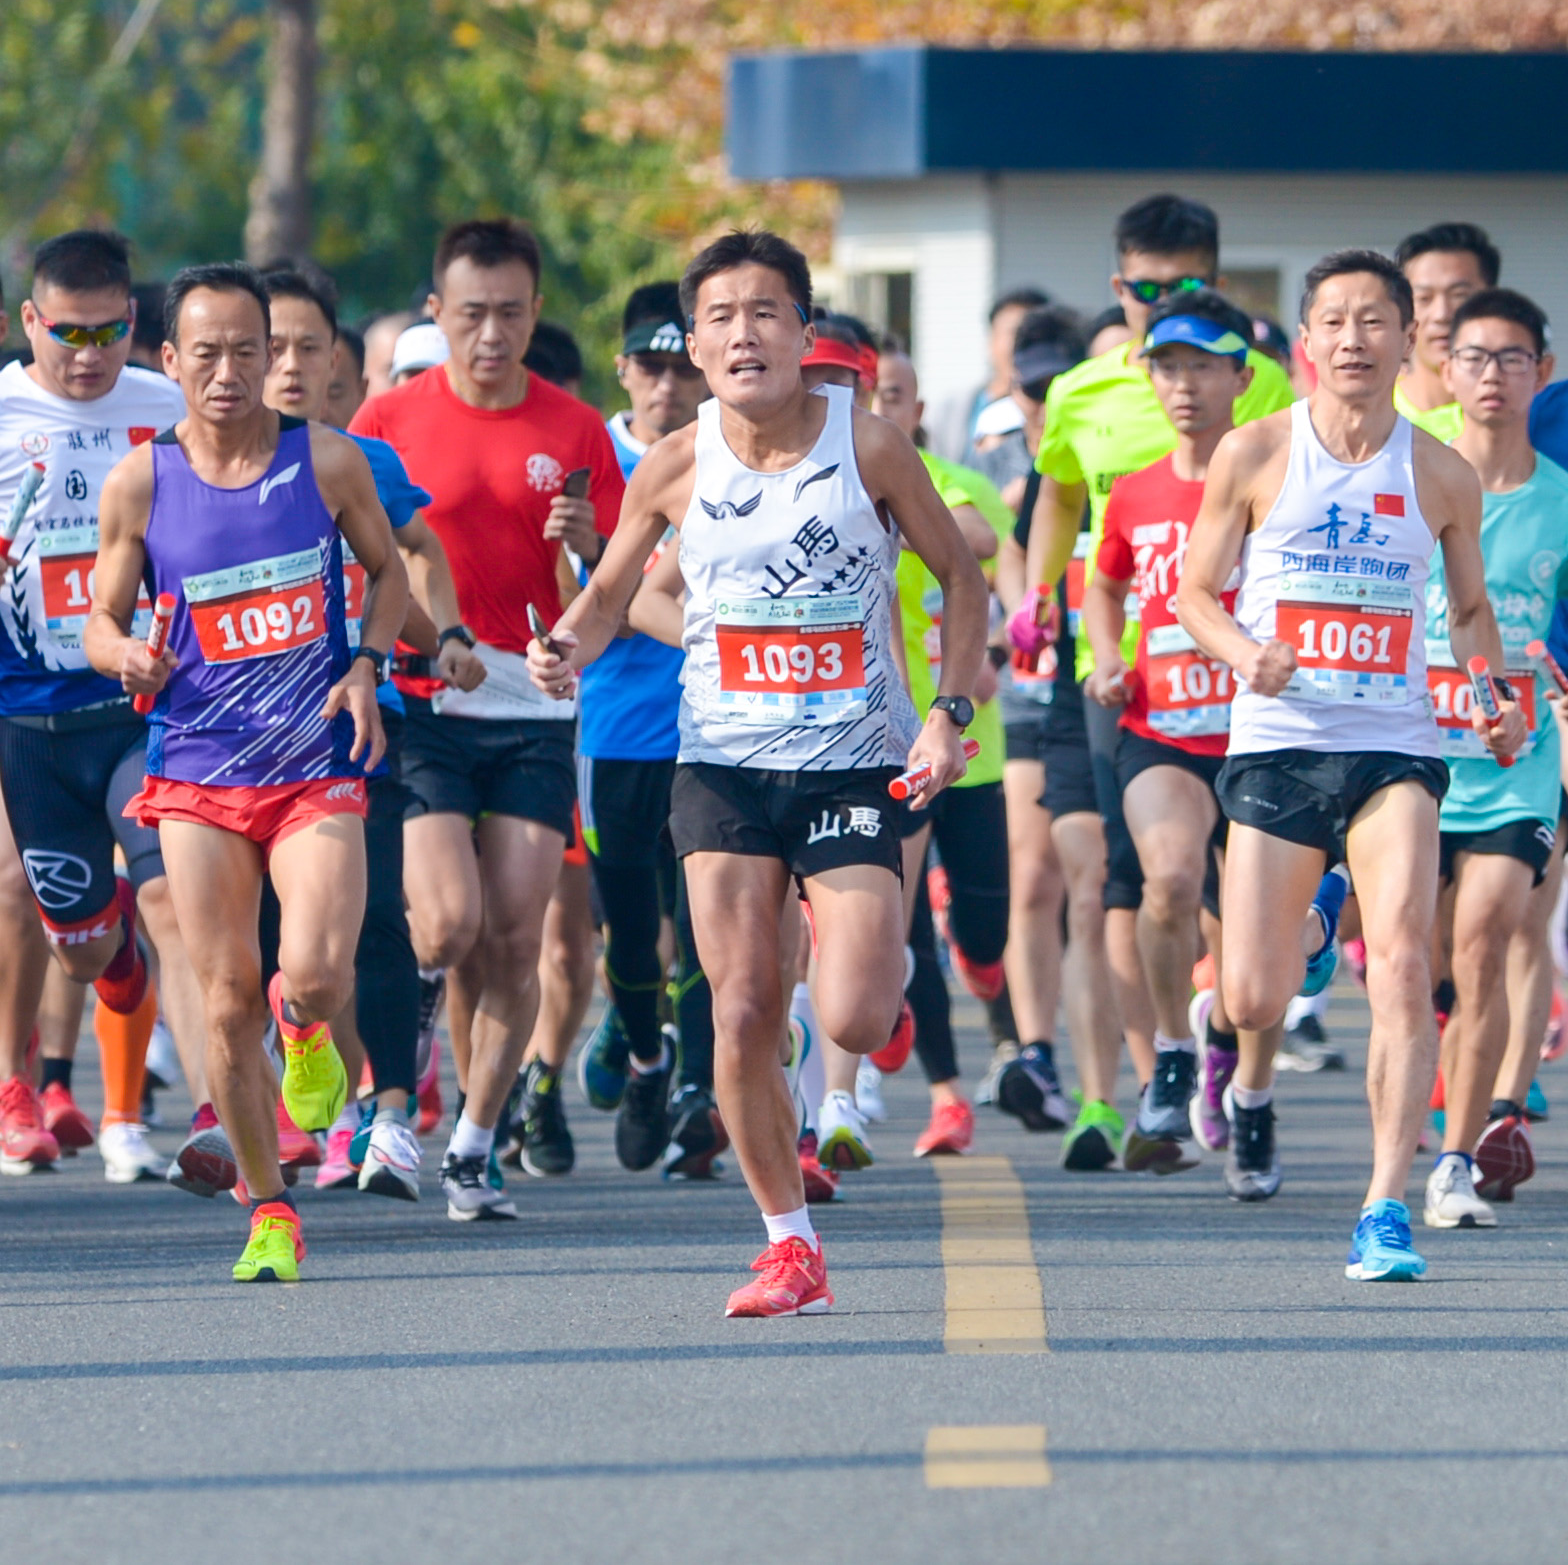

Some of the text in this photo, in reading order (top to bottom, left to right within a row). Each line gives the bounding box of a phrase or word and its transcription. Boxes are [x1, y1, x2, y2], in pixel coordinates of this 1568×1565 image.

[1307, 502, 1390, 549] 青岛
[217, 595, 315, 651] 1092
[1297, 619, 1392, 664] 1061
[741, 642, 844, 683] 1093
[1166, 661, 1230, 702] 107
[807, 806, 883, 845] 山馬
